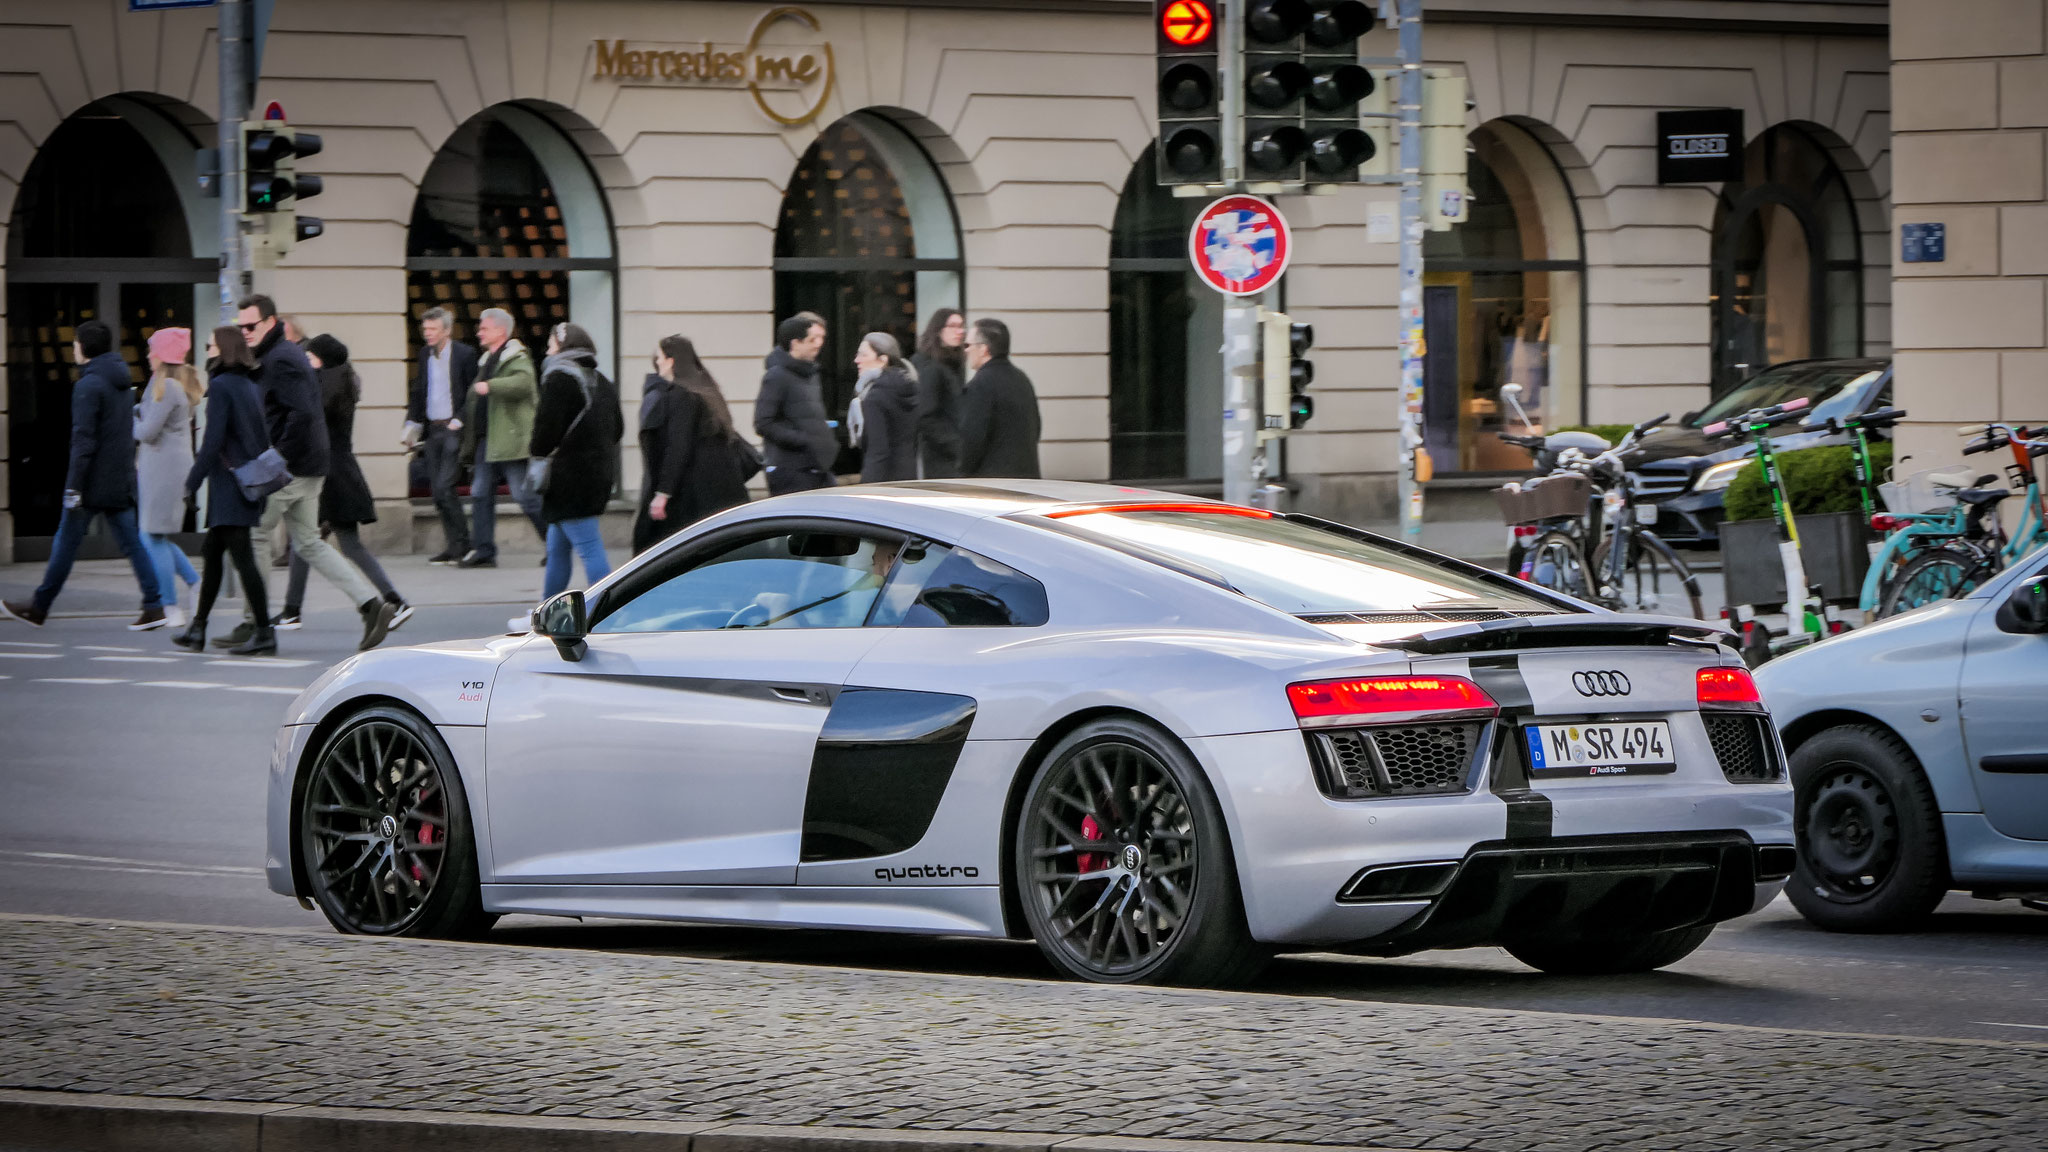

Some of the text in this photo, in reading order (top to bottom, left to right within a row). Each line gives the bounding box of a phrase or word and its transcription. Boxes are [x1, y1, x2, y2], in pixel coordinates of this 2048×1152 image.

[594, 39, 822, 82] Mercedes me
[1670, 138, 1727, 153] CLOSED
[461, 681, 484, 689] V10
[458, 692, 483, 701] Audi
[1550, 727, 1664, 762] M SR 494
[1534, 751, 1541, 761] D
[1610, 766, 1627, 774] Sport
[875, 864, 979, 882] quattro
